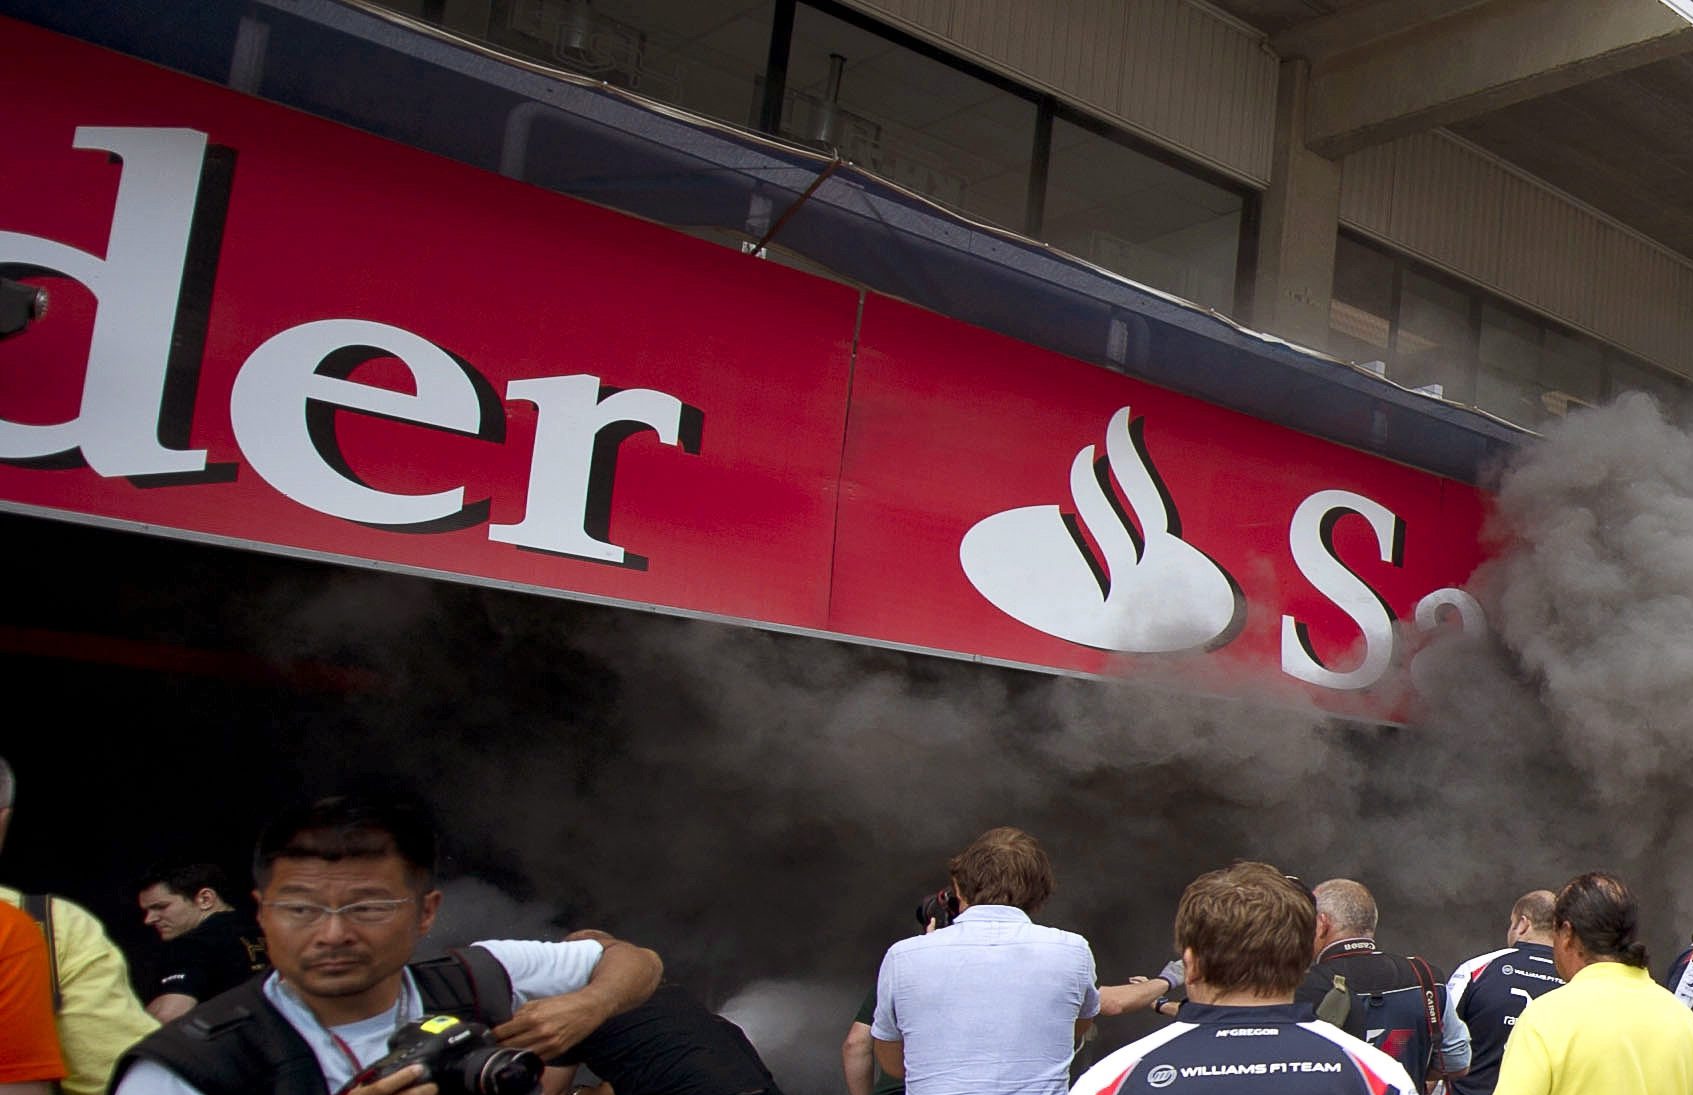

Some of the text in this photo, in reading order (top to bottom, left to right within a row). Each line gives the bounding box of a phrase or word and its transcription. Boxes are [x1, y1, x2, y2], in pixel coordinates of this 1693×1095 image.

[0, 126, 690, 566] der
[1180, 1061, 1341, 1078] WILLIAMS F1 TEAM
